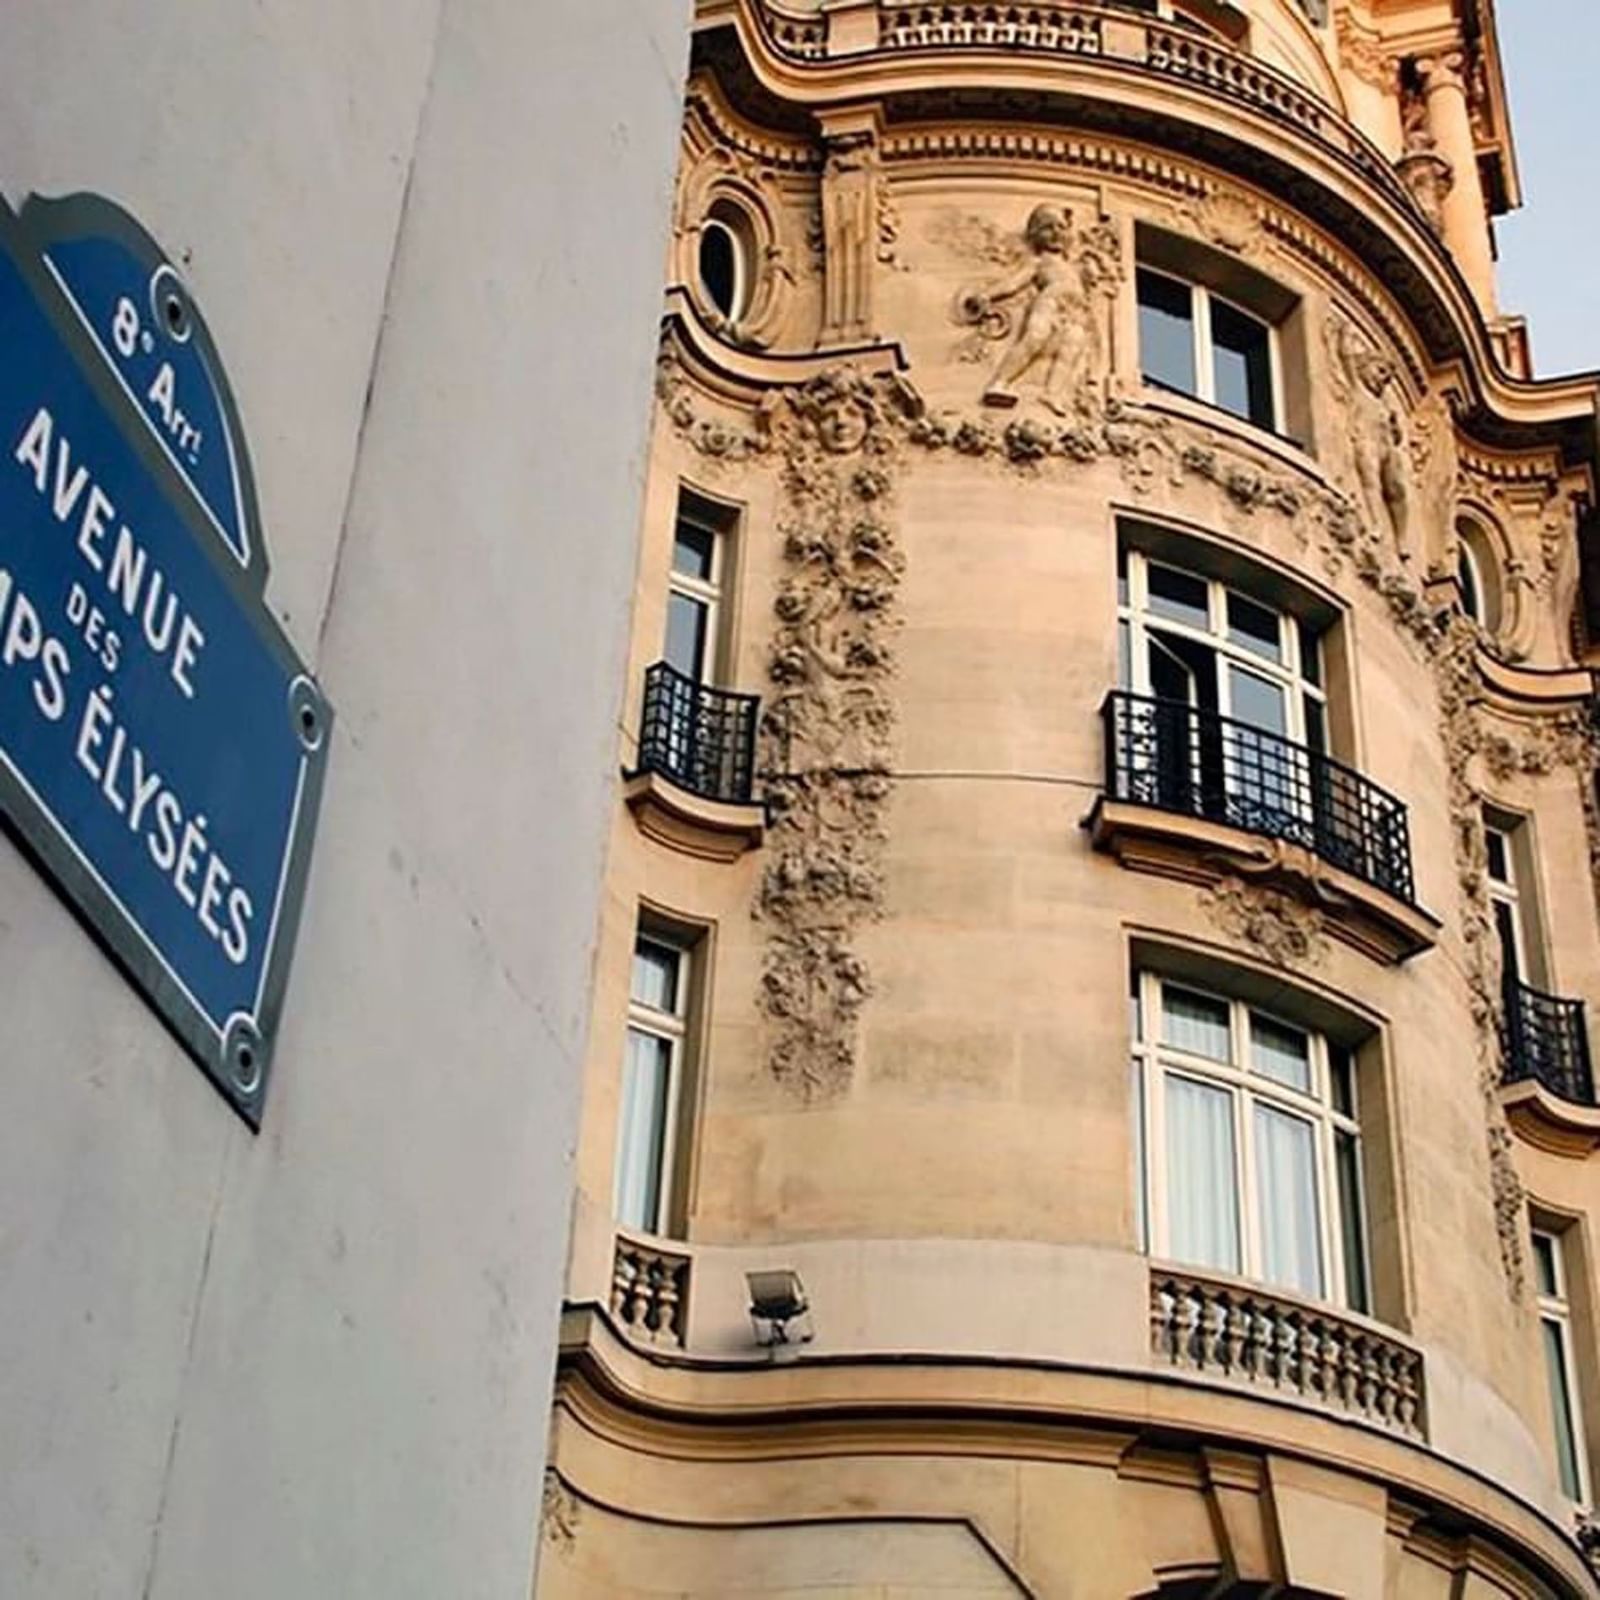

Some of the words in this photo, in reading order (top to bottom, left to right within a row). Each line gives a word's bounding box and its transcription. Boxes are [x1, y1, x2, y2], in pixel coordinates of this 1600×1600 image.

[15, 407, 205, 699] AVENUE
[66, 582, 122, 672] DES
[76, 683, 254, 965] ÉLYSÉES
